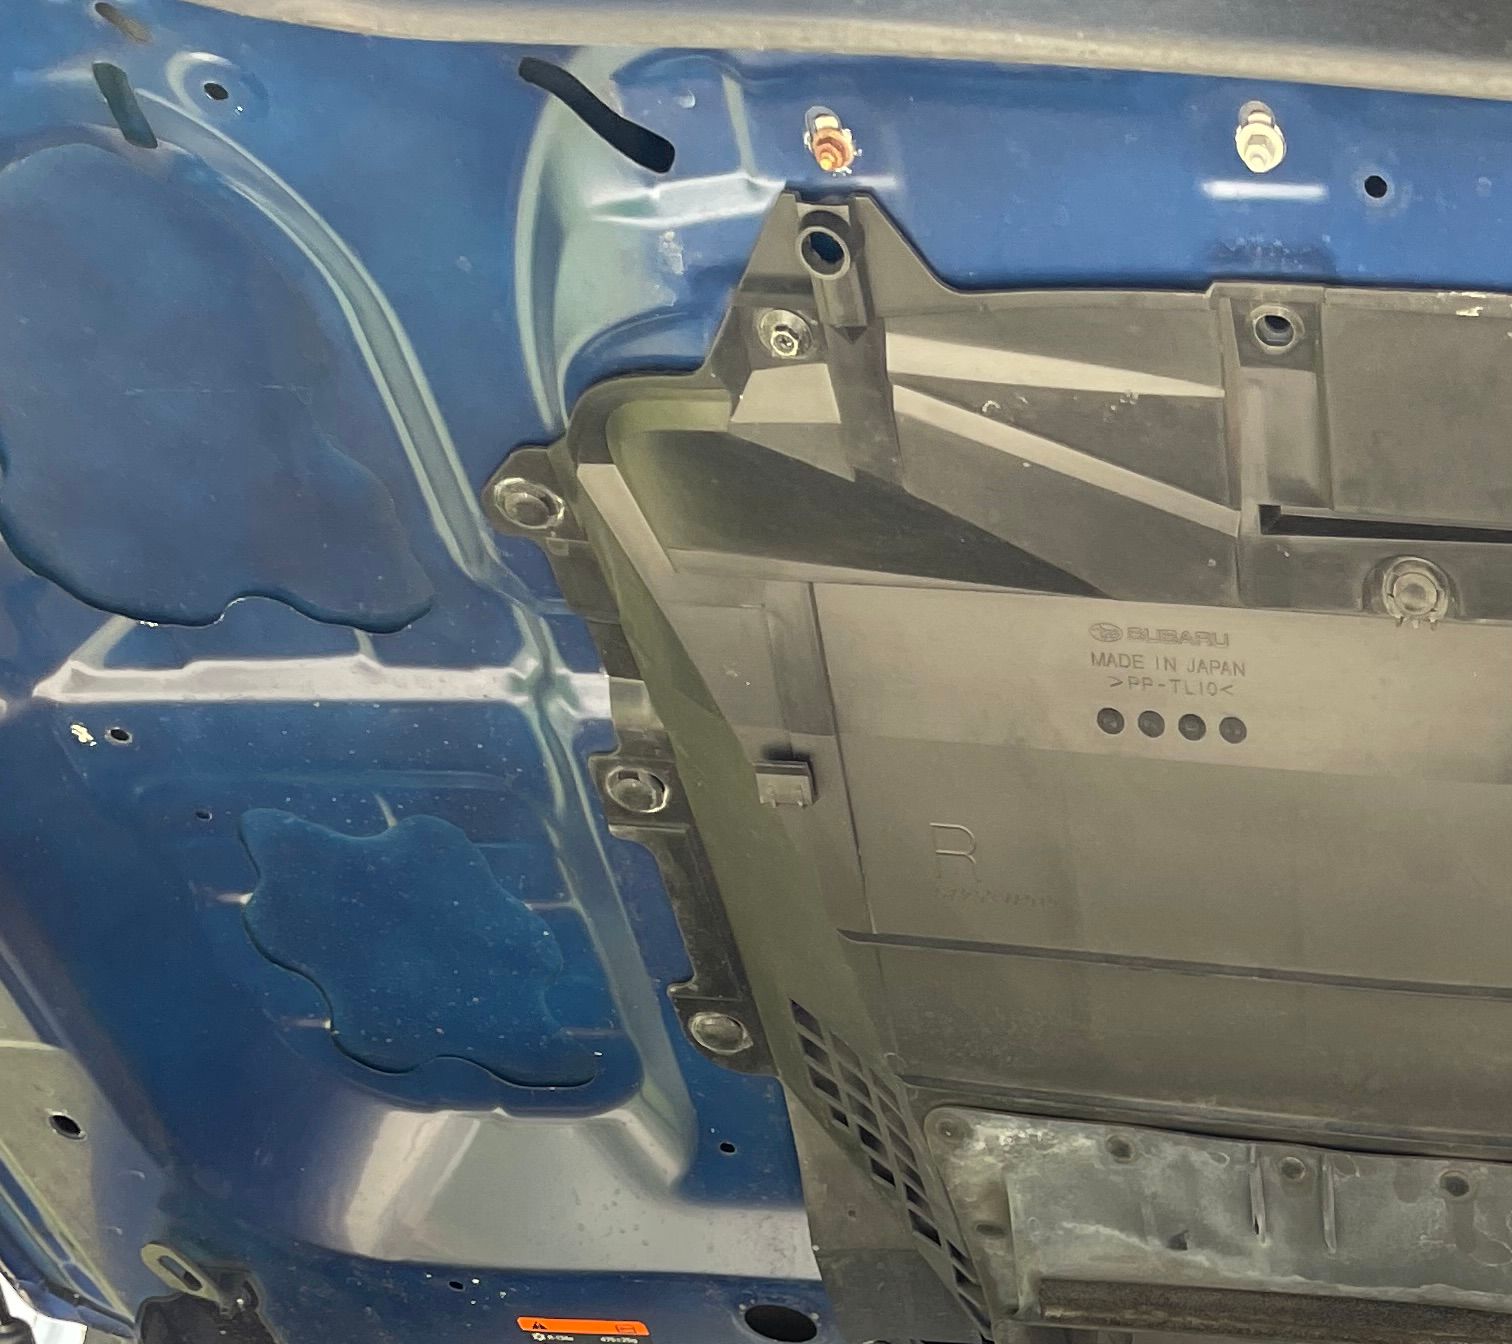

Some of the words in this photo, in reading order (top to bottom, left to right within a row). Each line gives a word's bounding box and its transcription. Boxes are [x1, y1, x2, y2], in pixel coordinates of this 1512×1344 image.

[1126, 626, 1230, 648] SUBARU
[1090, 651, 1145, 669] MADE
[1155, 655, 1177, 673] IN
[1186, 658, 1247, 677] JAPAN
